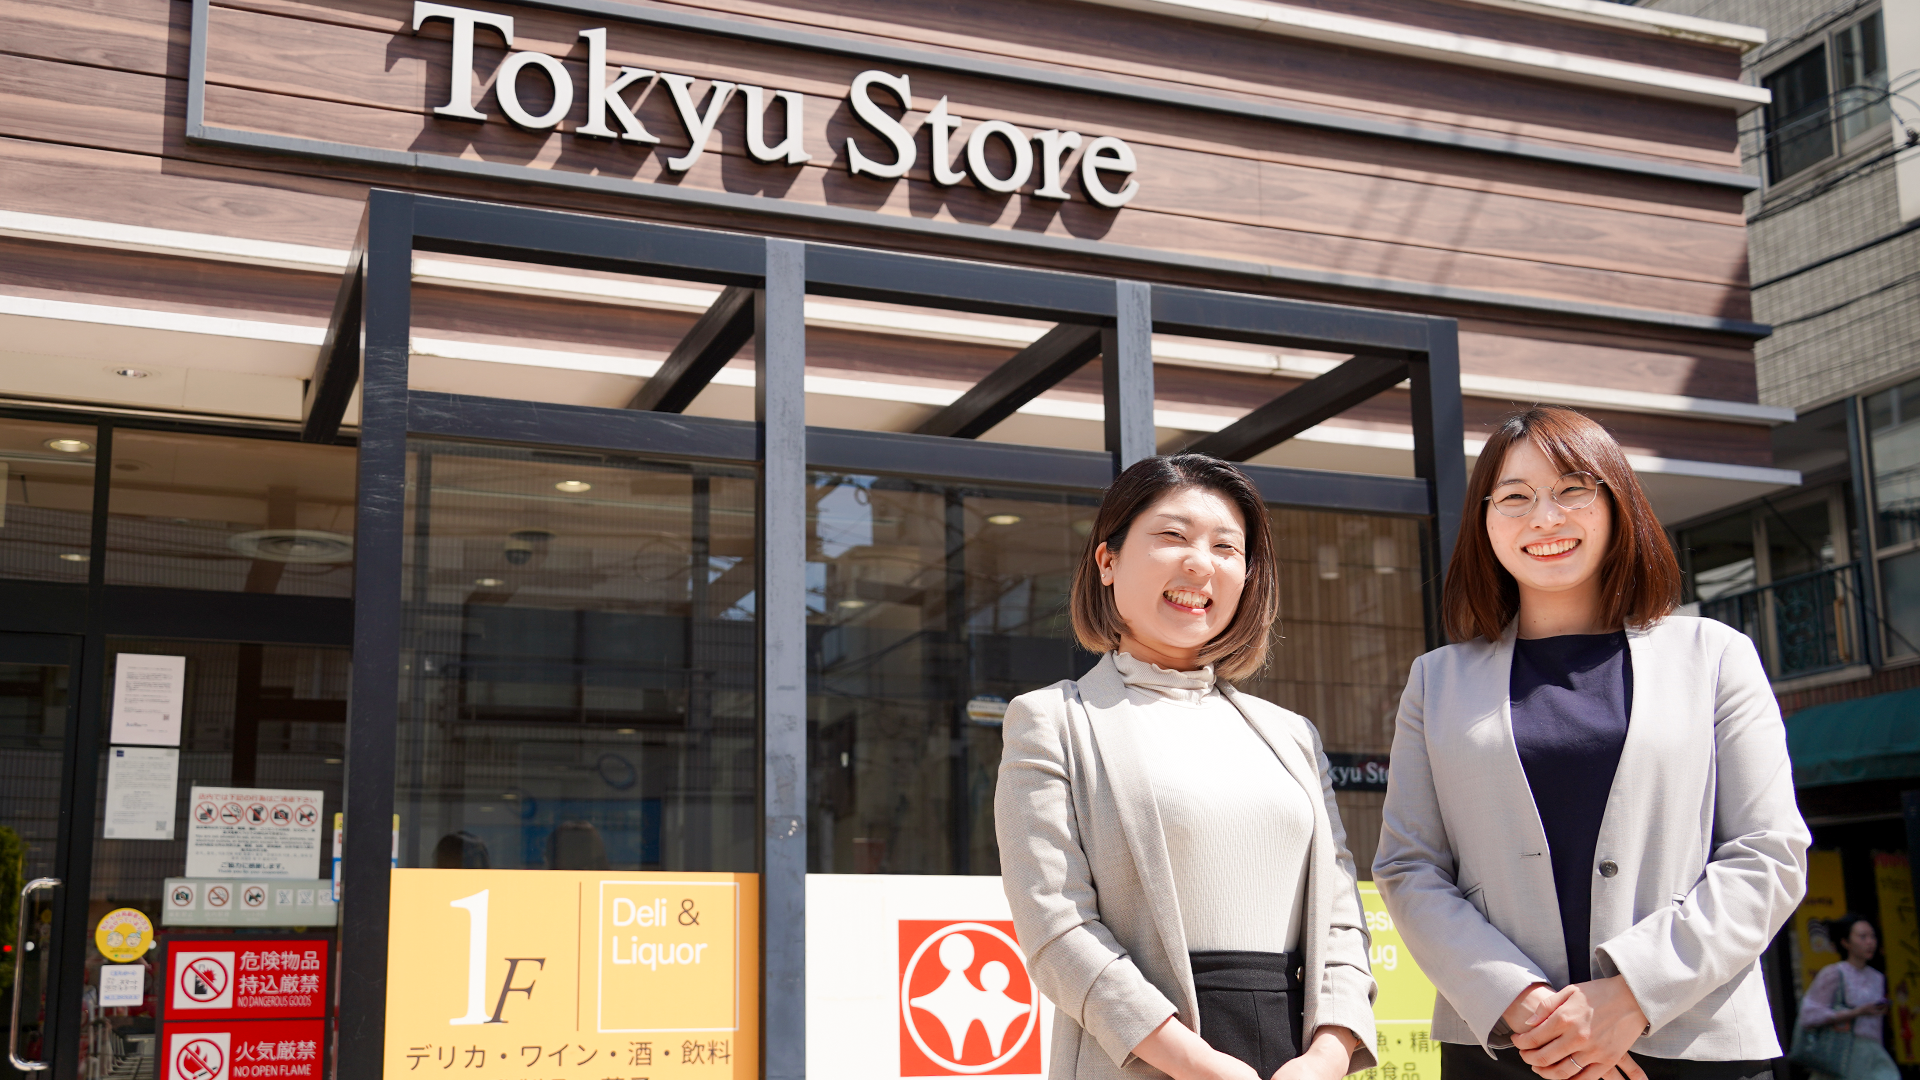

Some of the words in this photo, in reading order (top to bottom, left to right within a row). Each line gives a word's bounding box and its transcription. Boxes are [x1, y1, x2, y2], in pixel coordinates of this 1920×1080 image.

[413, 0, 811, 171] Tokyu
[846, 70, 1140, 208] Store
[612, 897, 668, 928] Deli
[677, 898, 700, 926] &
[239, 951, 320, 971] 危険物品
[612, 935, 708, 971] Liquor
[238, 974, 320, 995] 持込厳禁
[237, 996, 249, 1007] NO
[249, 995, 288, 1008] DANGEROUS
[288, 995, 312, 1007] GOODS
[234, 1040, 317, 1062] 火気厳禁
[406, 1039, 731, 1070] デリカ・ワイン・酒・飲料
[233, 1066, 250, 1078] NO
[251, 1065, 278, 1077] OPEN
[279, 1064, 312, 1076] FLAME
